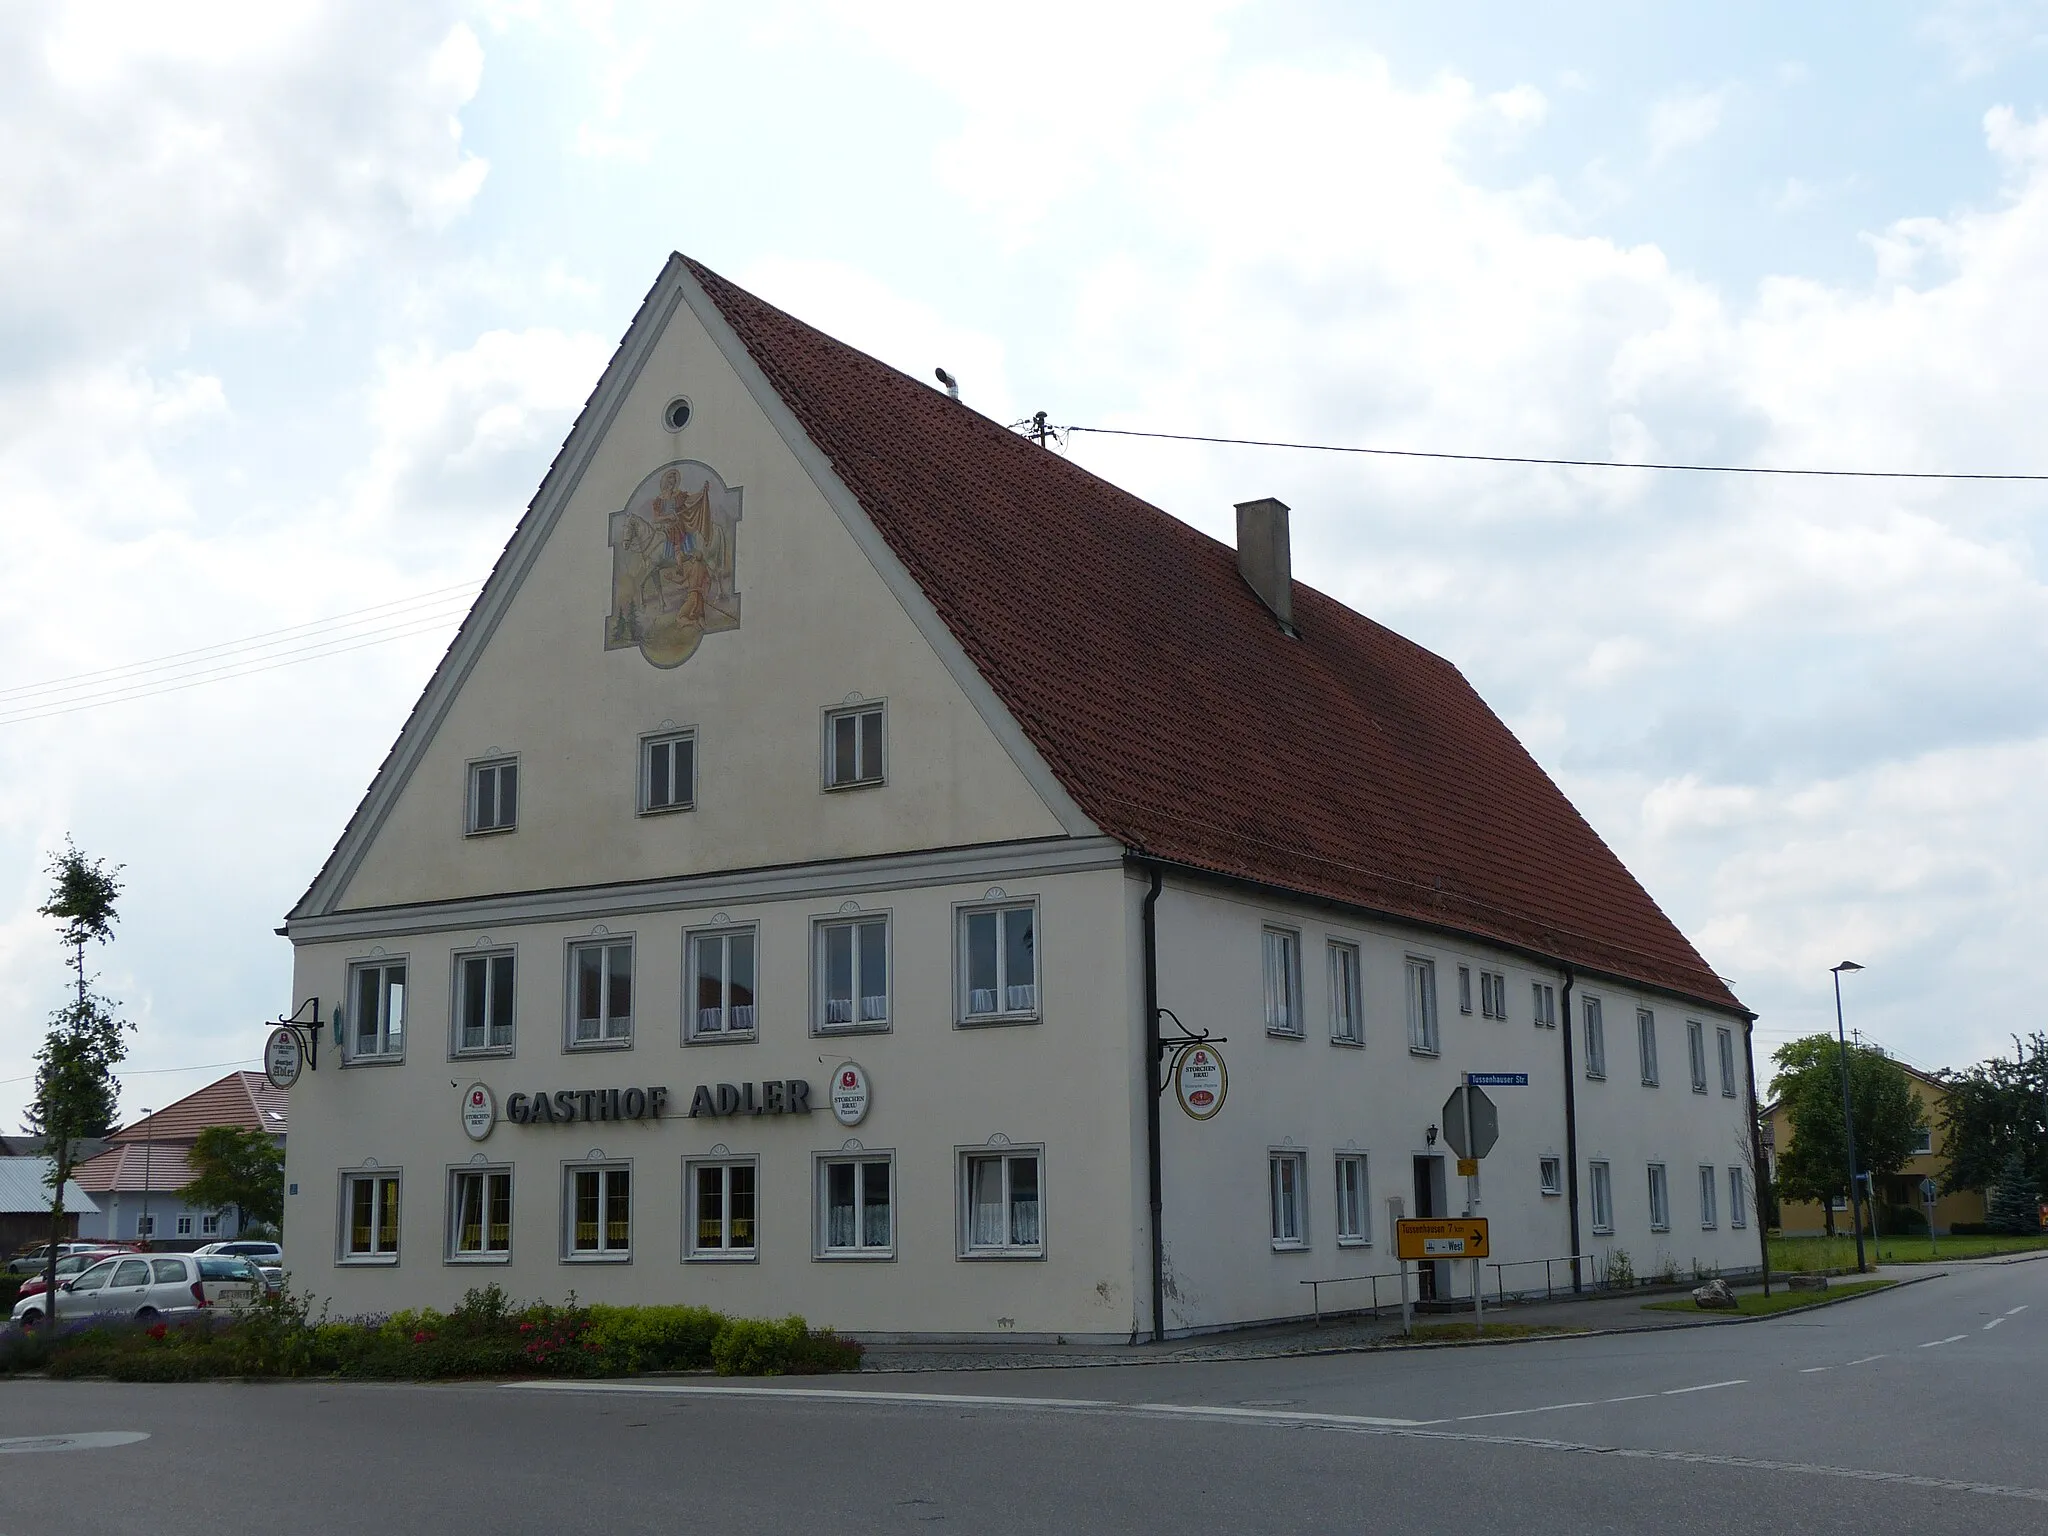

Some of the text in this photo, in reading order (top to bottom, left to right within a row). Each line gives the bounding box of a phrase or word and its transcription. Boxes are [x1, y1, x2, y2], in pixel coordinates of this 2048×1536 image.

[1186, 1065, 1216, 1073] STORCHEN
[1472, 1075, 1527, 1084] Tussenhauser Str.
[506, 1080, 812, 1123] GASTHOF ADLER
[1402, 1224, 1465, 1234] Tussenhausen 7 km
[1448, 1241, 1464, 1251] West
